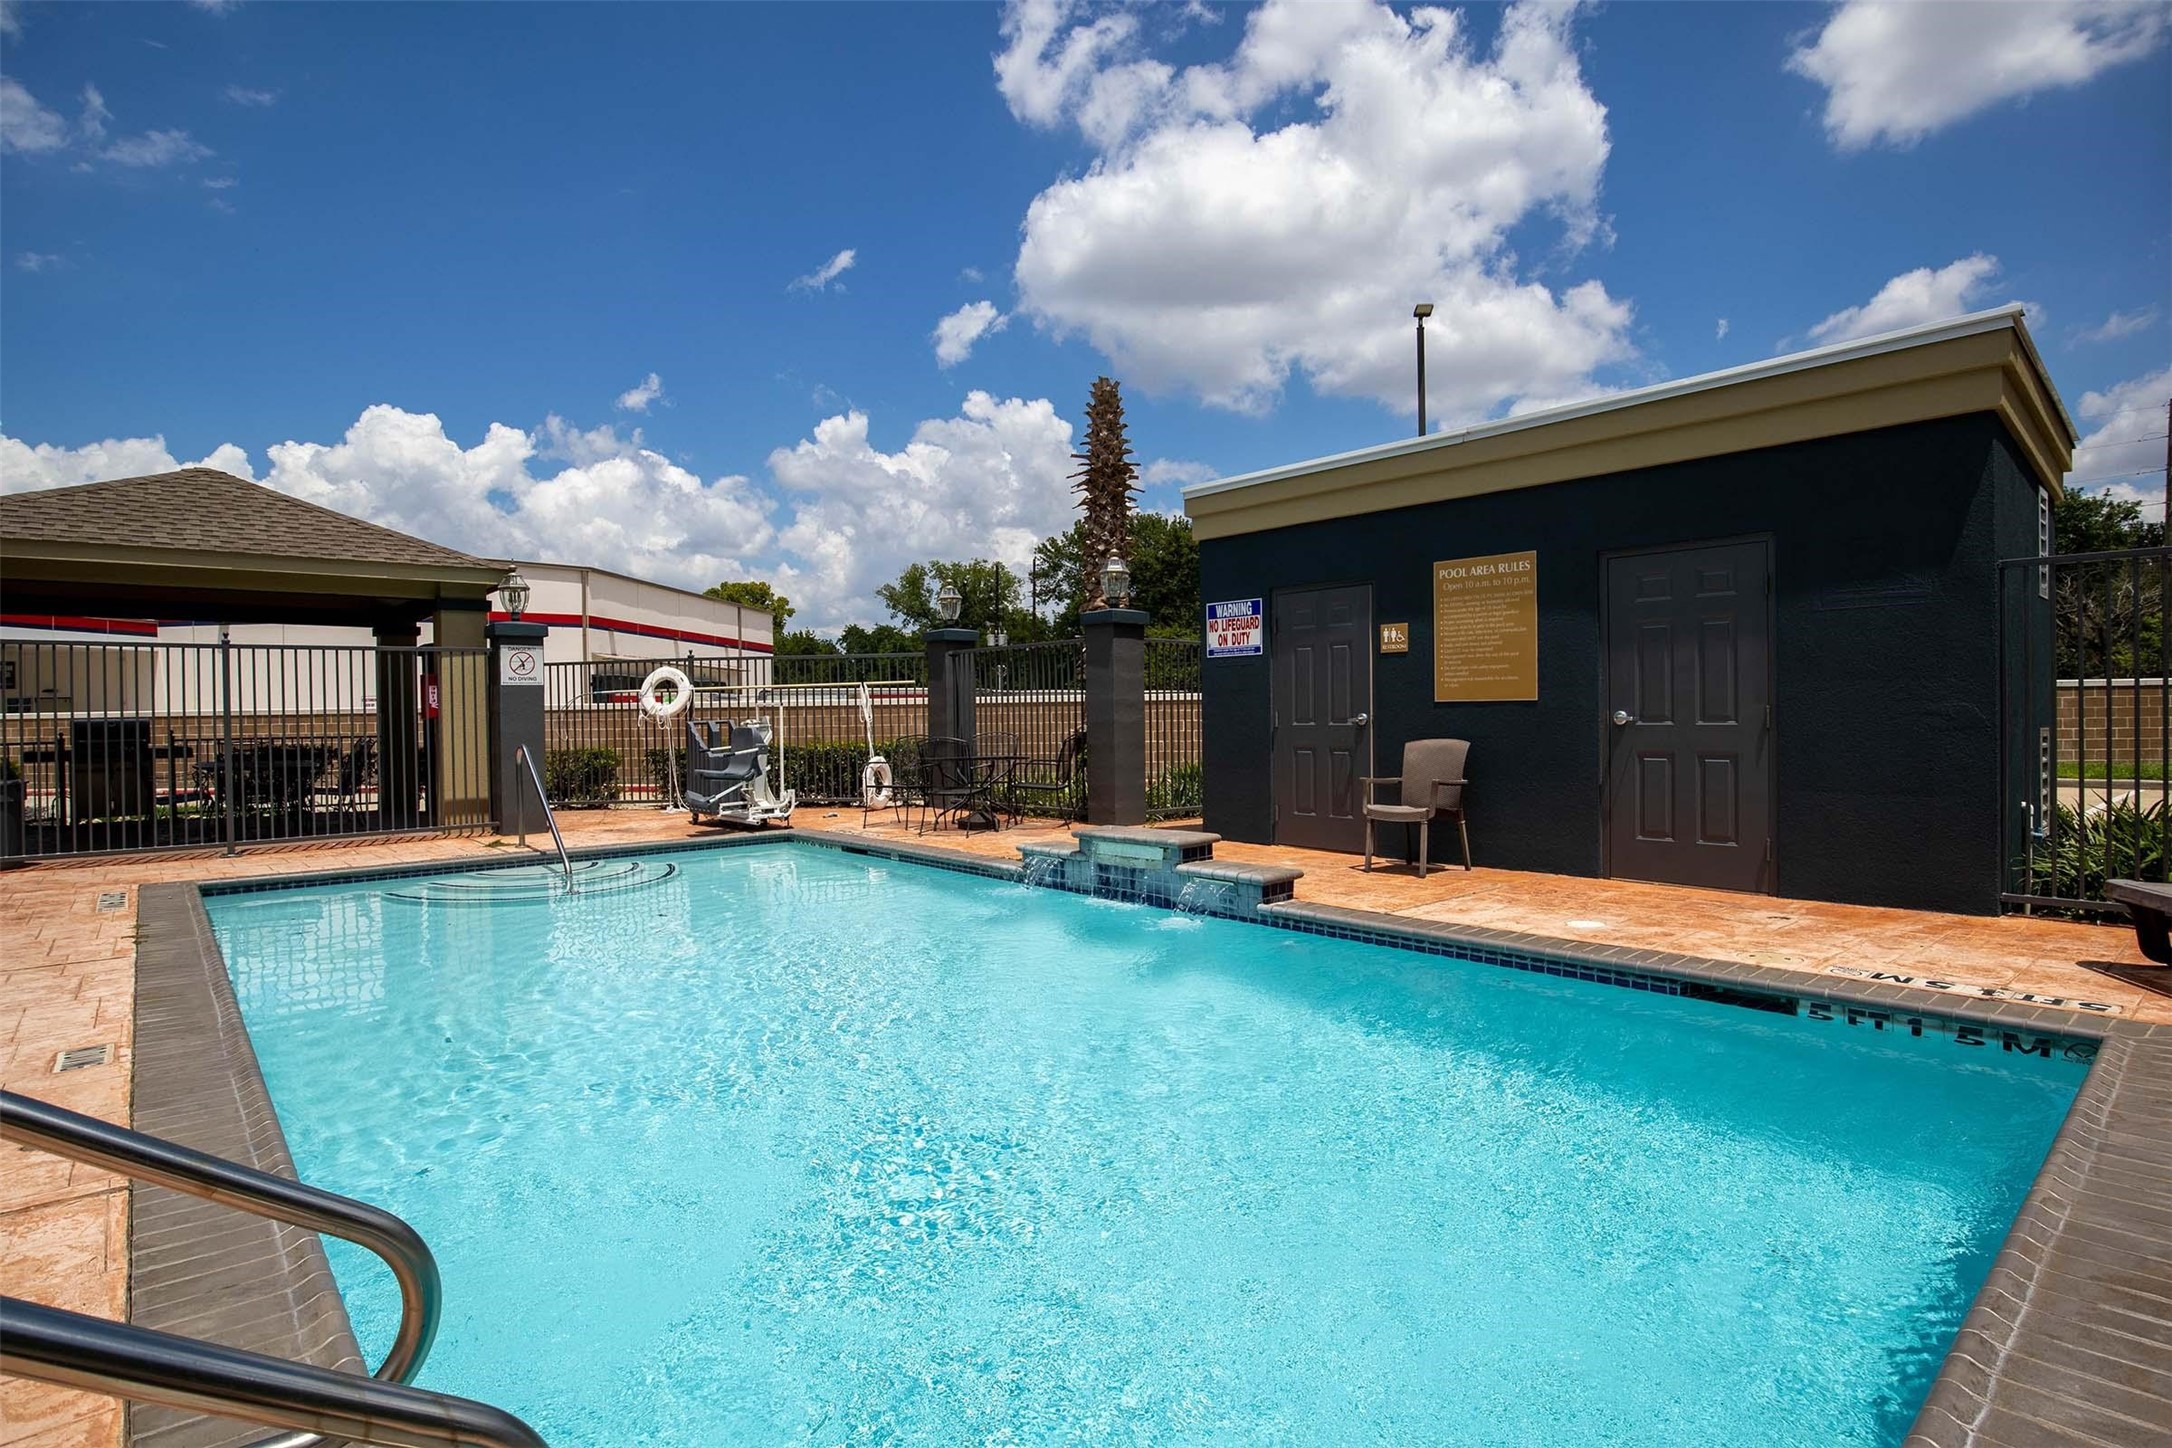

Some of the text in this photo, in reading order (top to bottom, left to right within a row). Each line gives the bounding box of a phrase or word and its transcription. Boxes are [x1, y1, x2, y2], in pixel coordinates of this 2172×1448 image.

[1439, 560, 1531, 580] POOL AREA RULES
[1443, 575, 1530, 592] Open 10 a.m. to 10 p.m.
[1215, 602, 1252, 618] WARNING
[1208, 616, 1259, 633] NO LIFEGUARD
[1217, 632, 1251, 647] ON DUTY
[1870, 972, 1915, 984] M
[1807, 1002, 1834, 1021] 5
[2002, 1031, 2052, 1058] M
